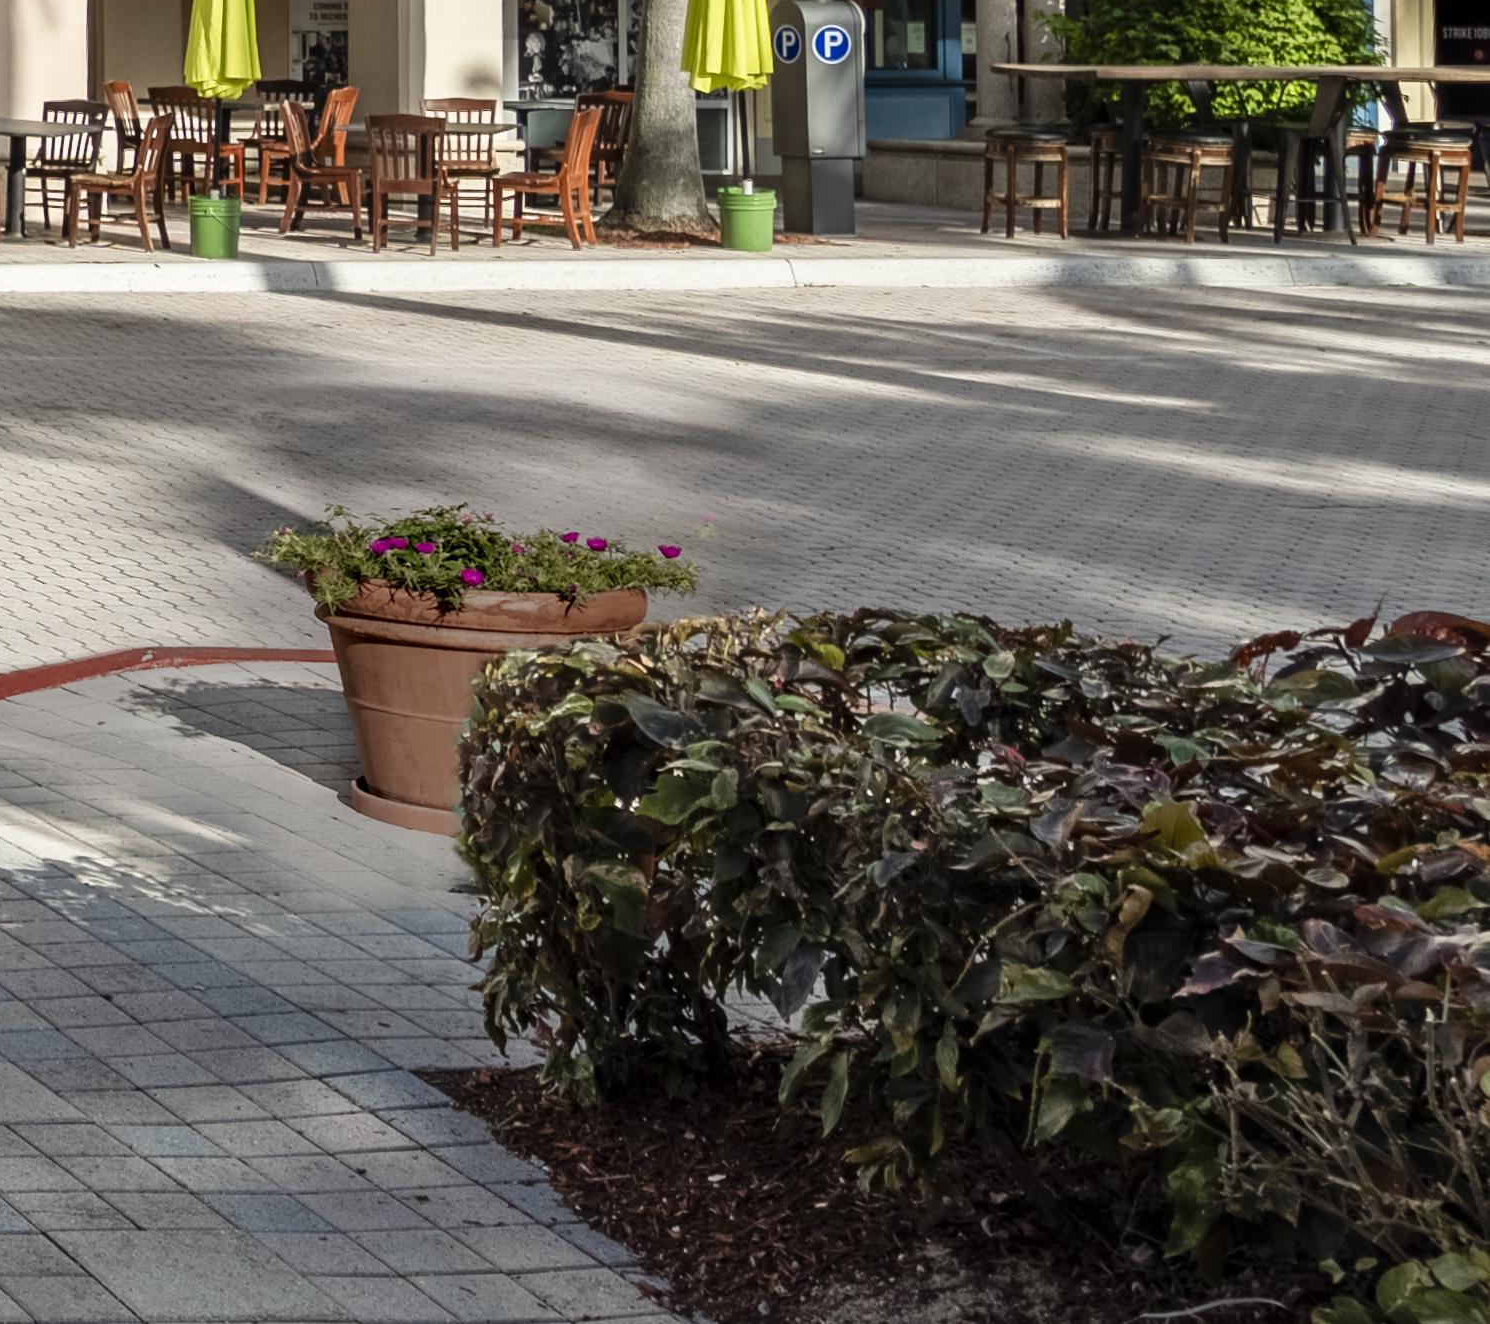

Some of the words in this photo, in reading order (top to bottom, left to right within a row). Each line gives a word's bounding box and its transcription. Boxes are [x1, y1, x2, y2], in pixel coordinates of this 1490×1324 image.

[313, 2, 343, 10] COMING
[309, 13, 319, 21] TO
[782, 31, 796, 58] P
[824, 30, 844, 58] P
